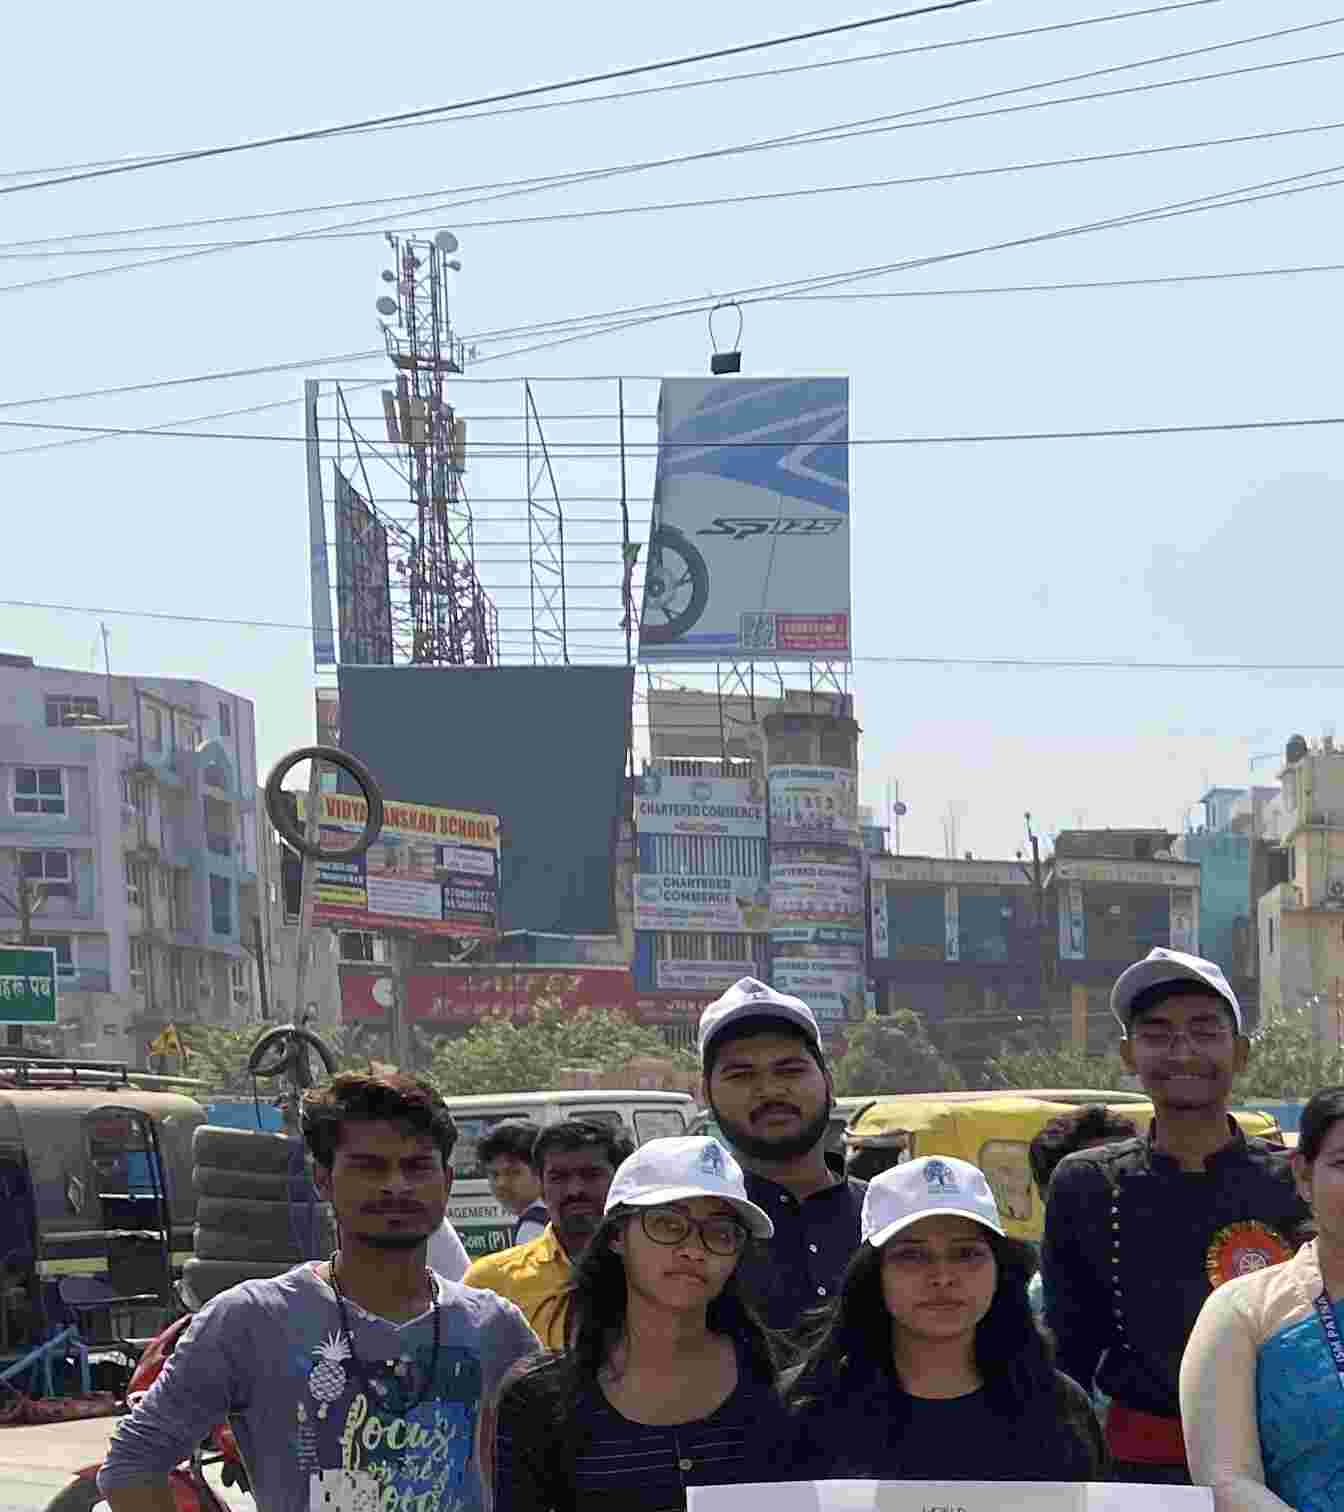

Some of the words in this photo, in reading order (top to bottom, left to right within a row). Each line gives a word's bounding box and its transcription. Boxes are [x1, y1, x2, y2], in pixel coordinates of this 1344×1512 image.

[639, 801, 701, 817] CHARTERED
[702, 802, 762, 820] COMMERCE
[438, 814, 495, 841] SCHOOL
[663, 877, 731, 890] CHARTERED
[663, 891, 730, 905] COMMERCE
[449, 1207, 497, 1217] AGEMENT
